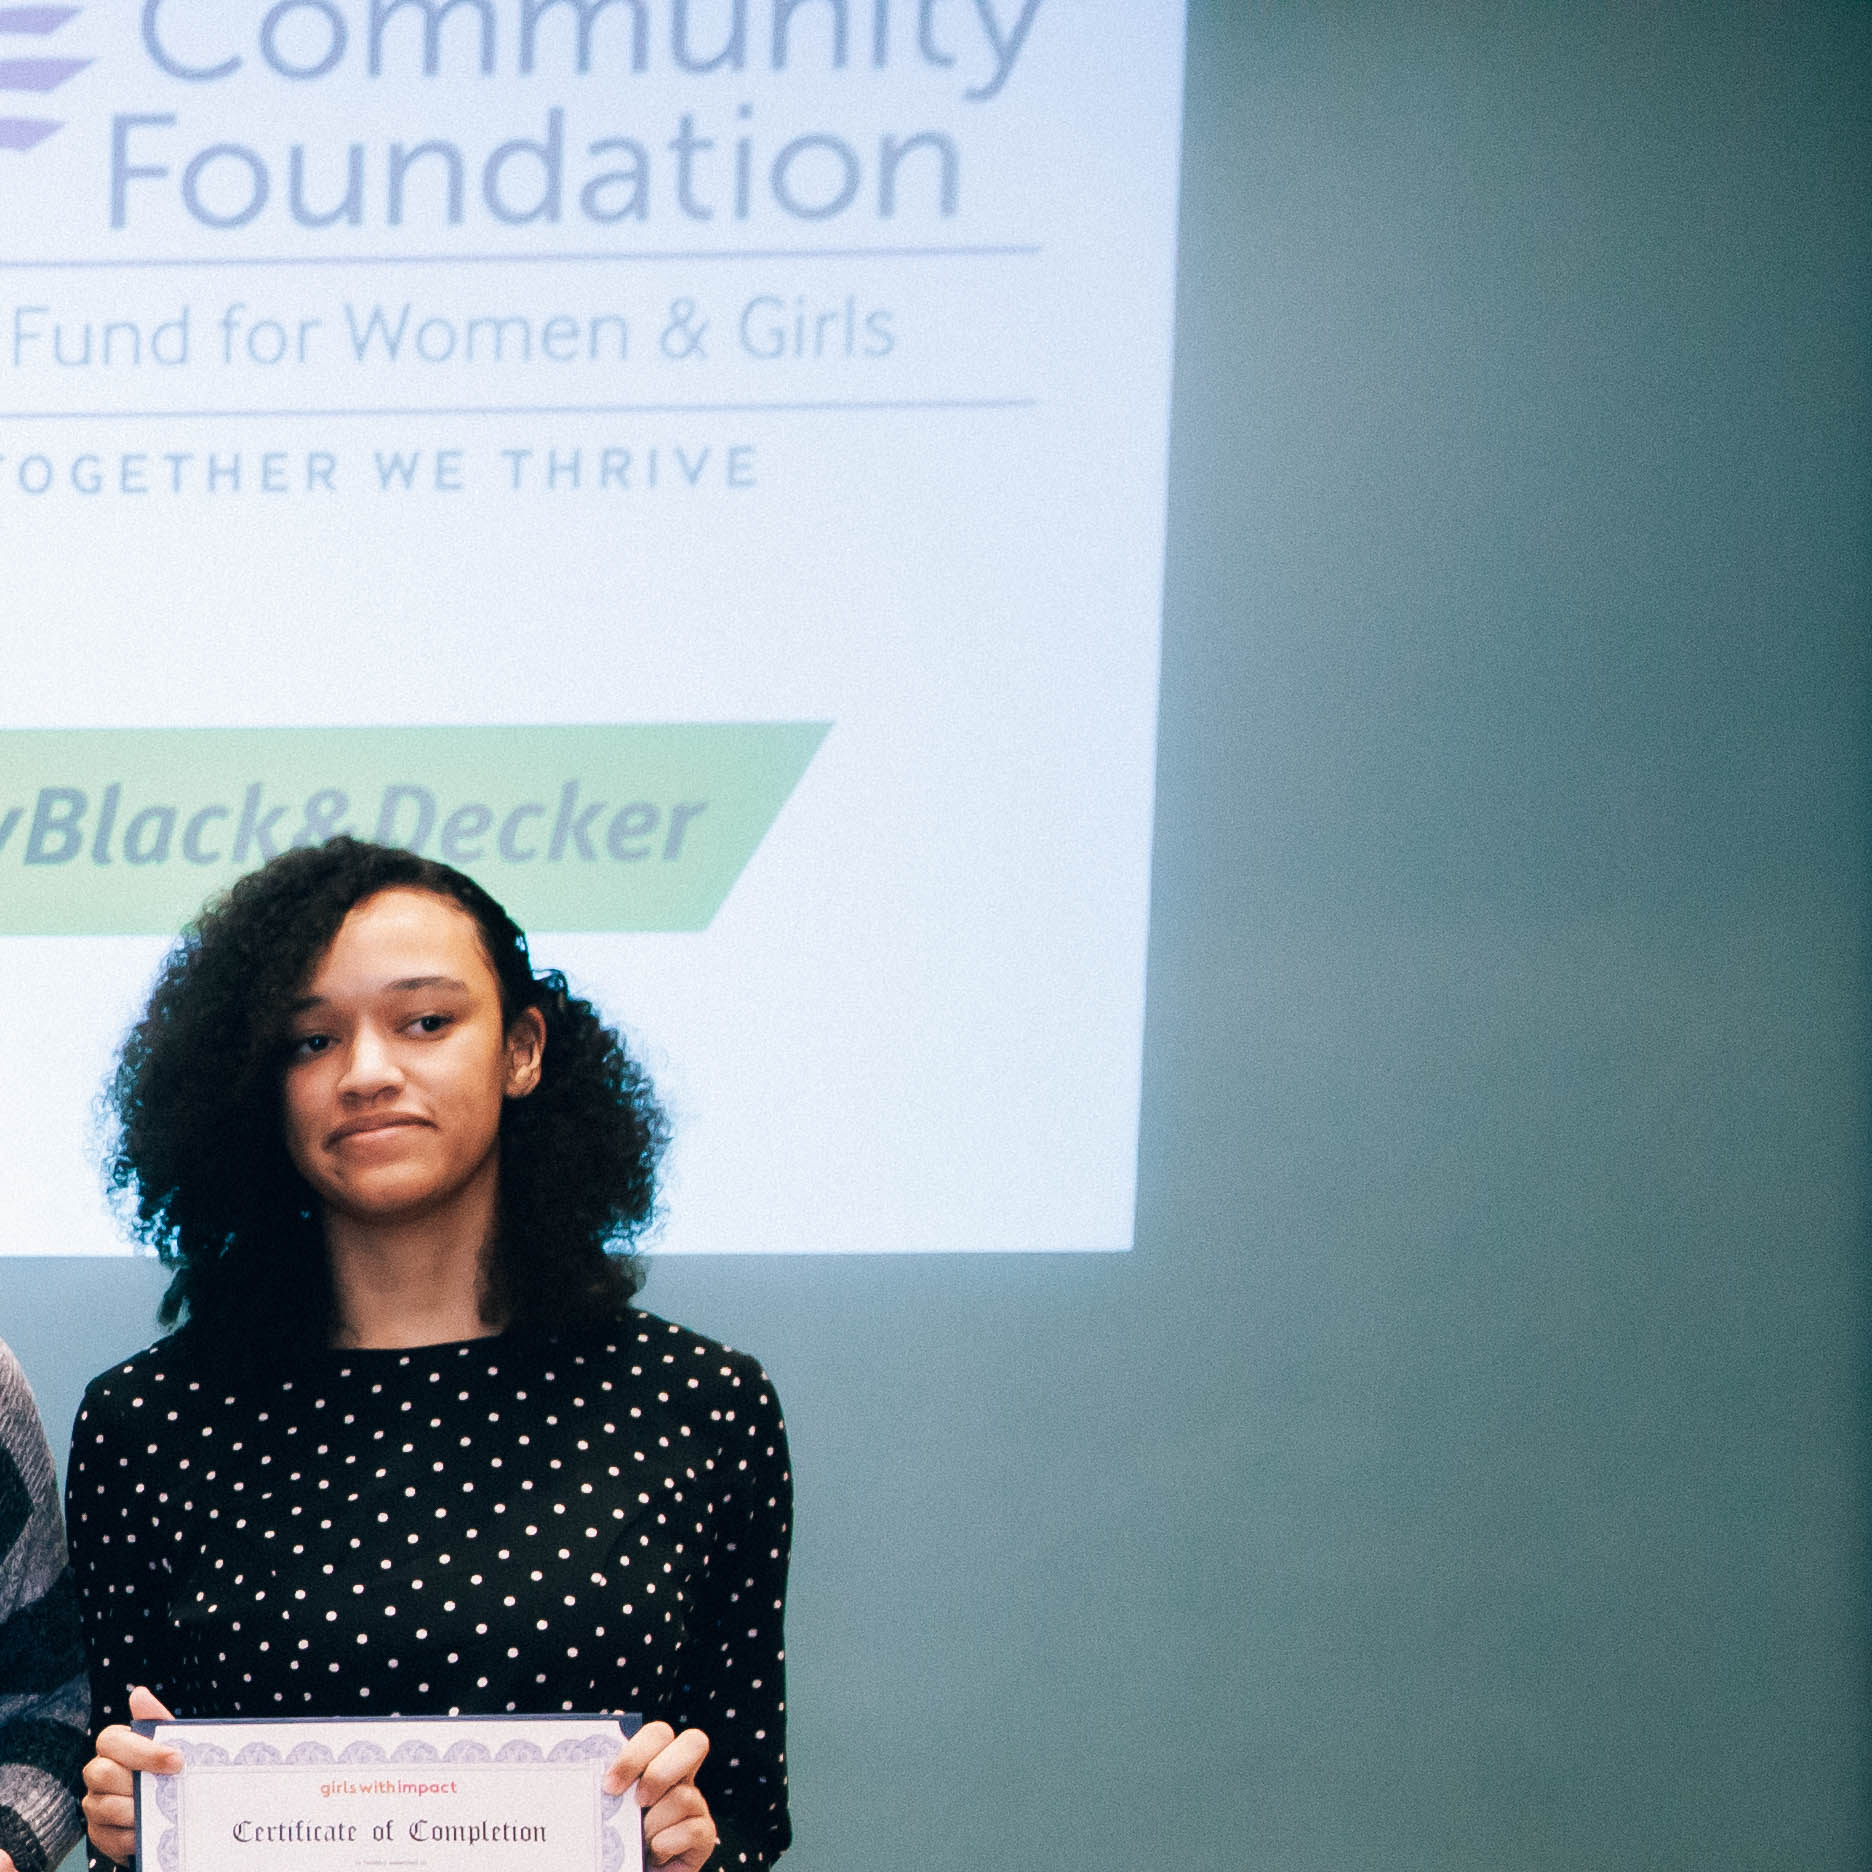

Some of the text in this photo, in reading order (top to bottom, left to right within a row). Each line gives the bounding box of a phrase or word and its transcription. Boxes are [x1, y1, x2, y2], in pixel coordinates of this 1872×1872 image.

[140, 0, 1046, 101] Community
[108, 105, 963, 233] Foundation
[11, 301, 192, 369] Fund
[216, 299, 323, 367] for
[343, 301, 631, 364] Women
[657, 297, 715, 361] &
[737, 292, 898, 361] Girls
[375, 449, 464, 493] WE
[502, 446, 759, 491] THRIVE
[232, 1818, 548, 1847] Certificate of Completion
